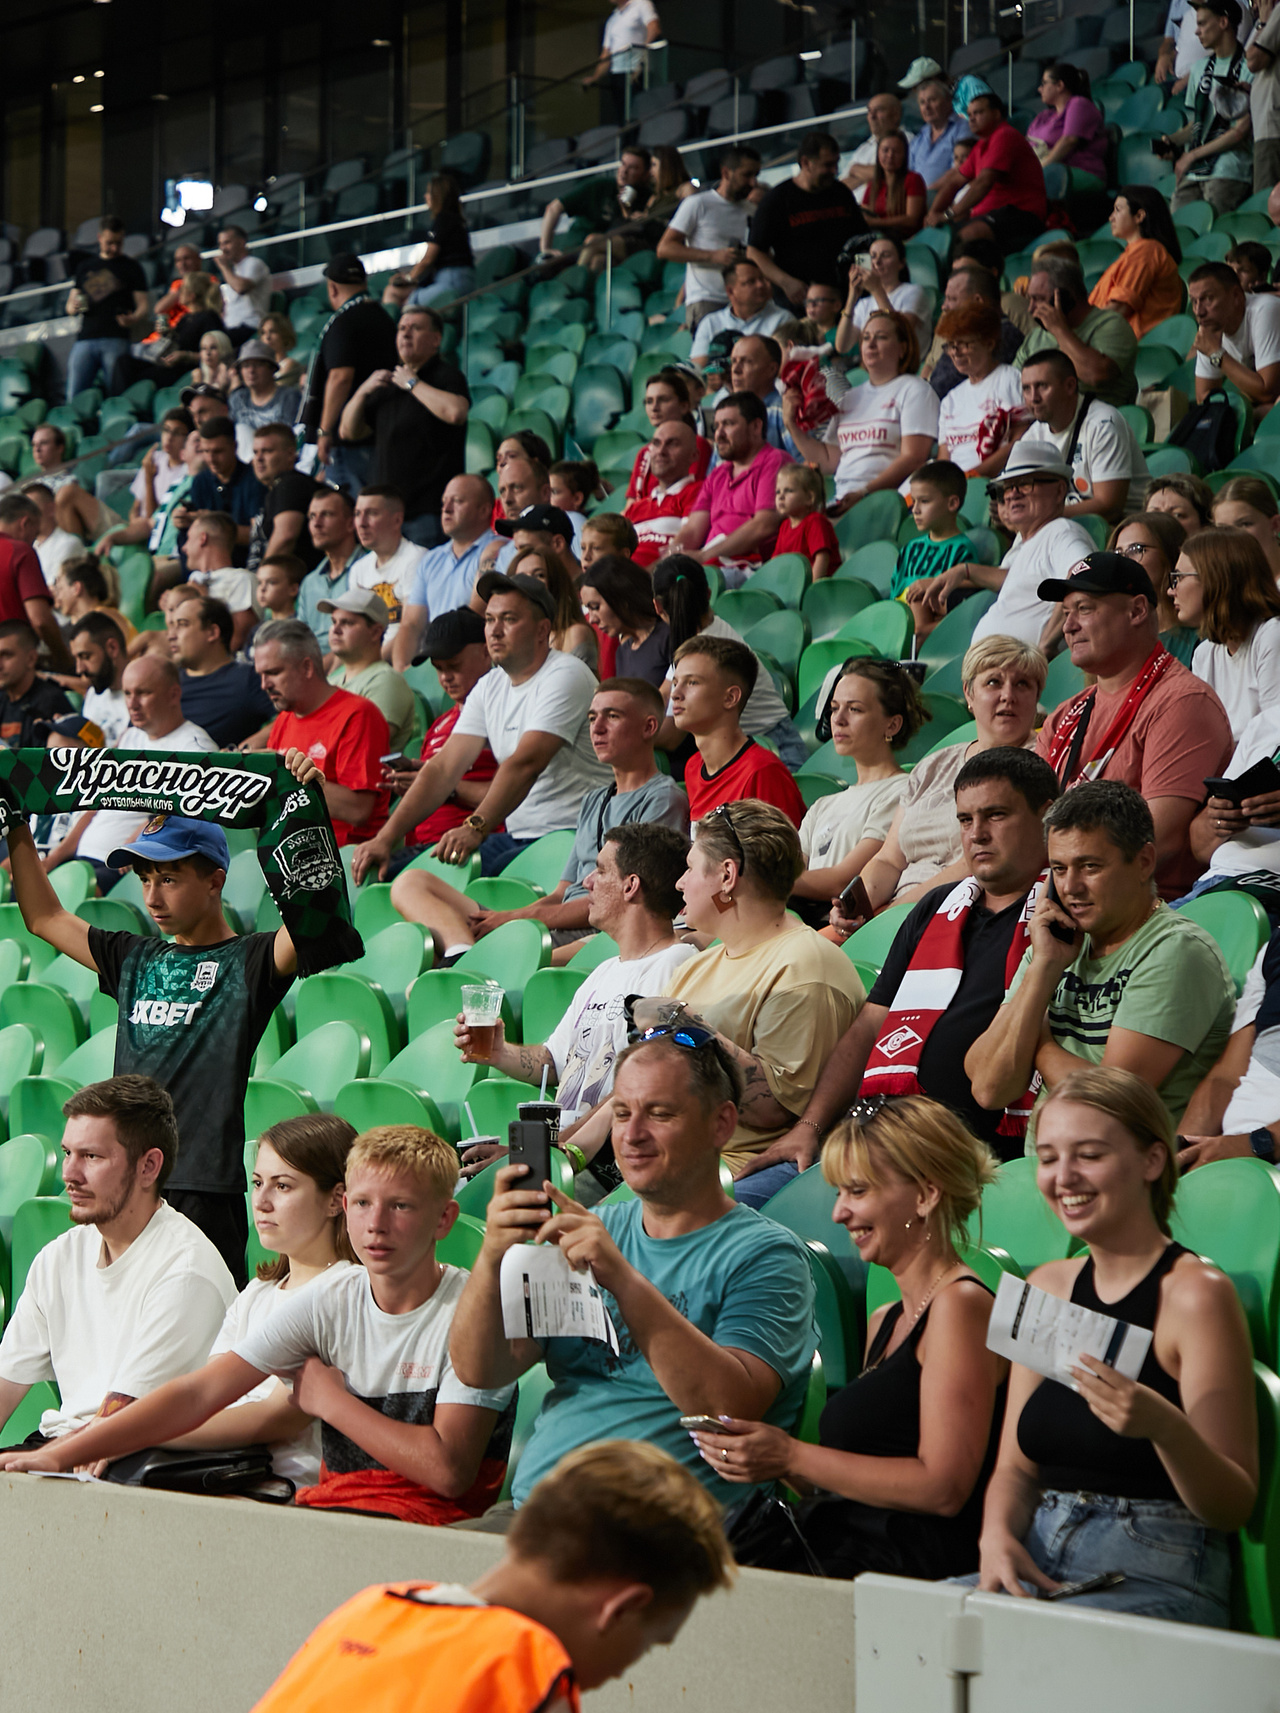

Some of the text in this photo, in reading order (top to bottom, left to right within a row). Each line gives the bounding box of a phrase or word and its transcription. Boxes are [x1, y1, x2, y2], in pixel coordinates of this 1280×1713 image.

[50, 748, 271, 819] Краснодар
[100, 796, 174, 811] ФУТБОЛЬНЫЙ КЛУБ
